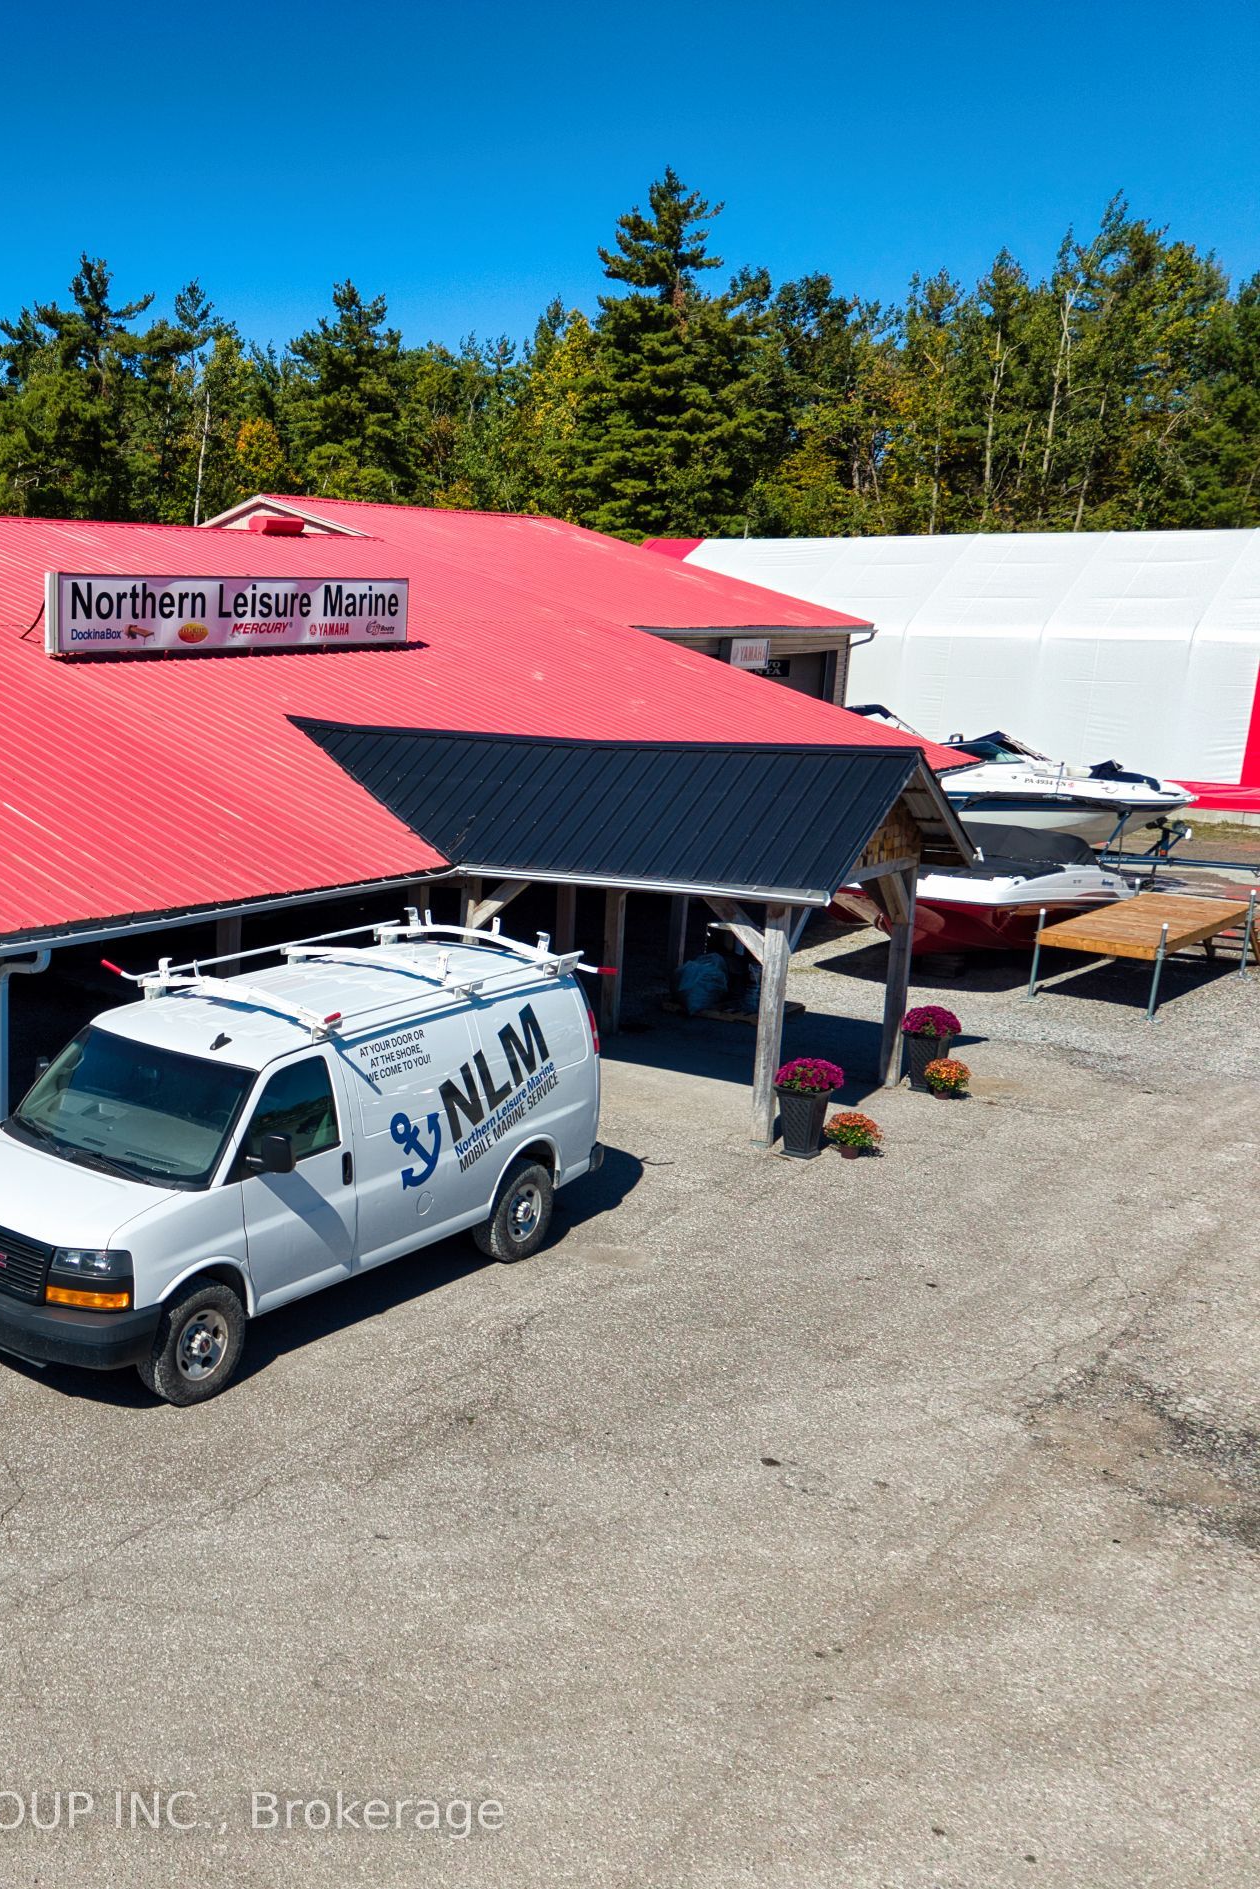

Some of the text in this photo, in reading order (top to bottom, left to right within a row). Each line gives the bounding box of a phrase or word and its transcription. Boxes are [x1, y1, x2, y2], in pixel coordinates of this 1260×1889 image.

[71, 582, 399, 619] Northern Leisure Marine
[71, 628, 121, 641] DockinaBox
[231, 622, 289, 635] MERCURY
[319, 623, 349, 636] YAMAHA
[740, 646, 766, 661] YAMAHA
[360, 1030, 425, 1058] AT YOUR DOOR OR
[370, 1044, 423, 1069] AT THE SHORE,
[366, 1053, 432, 1083] WE COME TO YOU!
[438, 1003, 550, 1144] NLM
[454, 1061, 555, 1158] Northern Leisure Marine
[459, 1070, 560, 1173] MOBILE MARINE SERVICE
